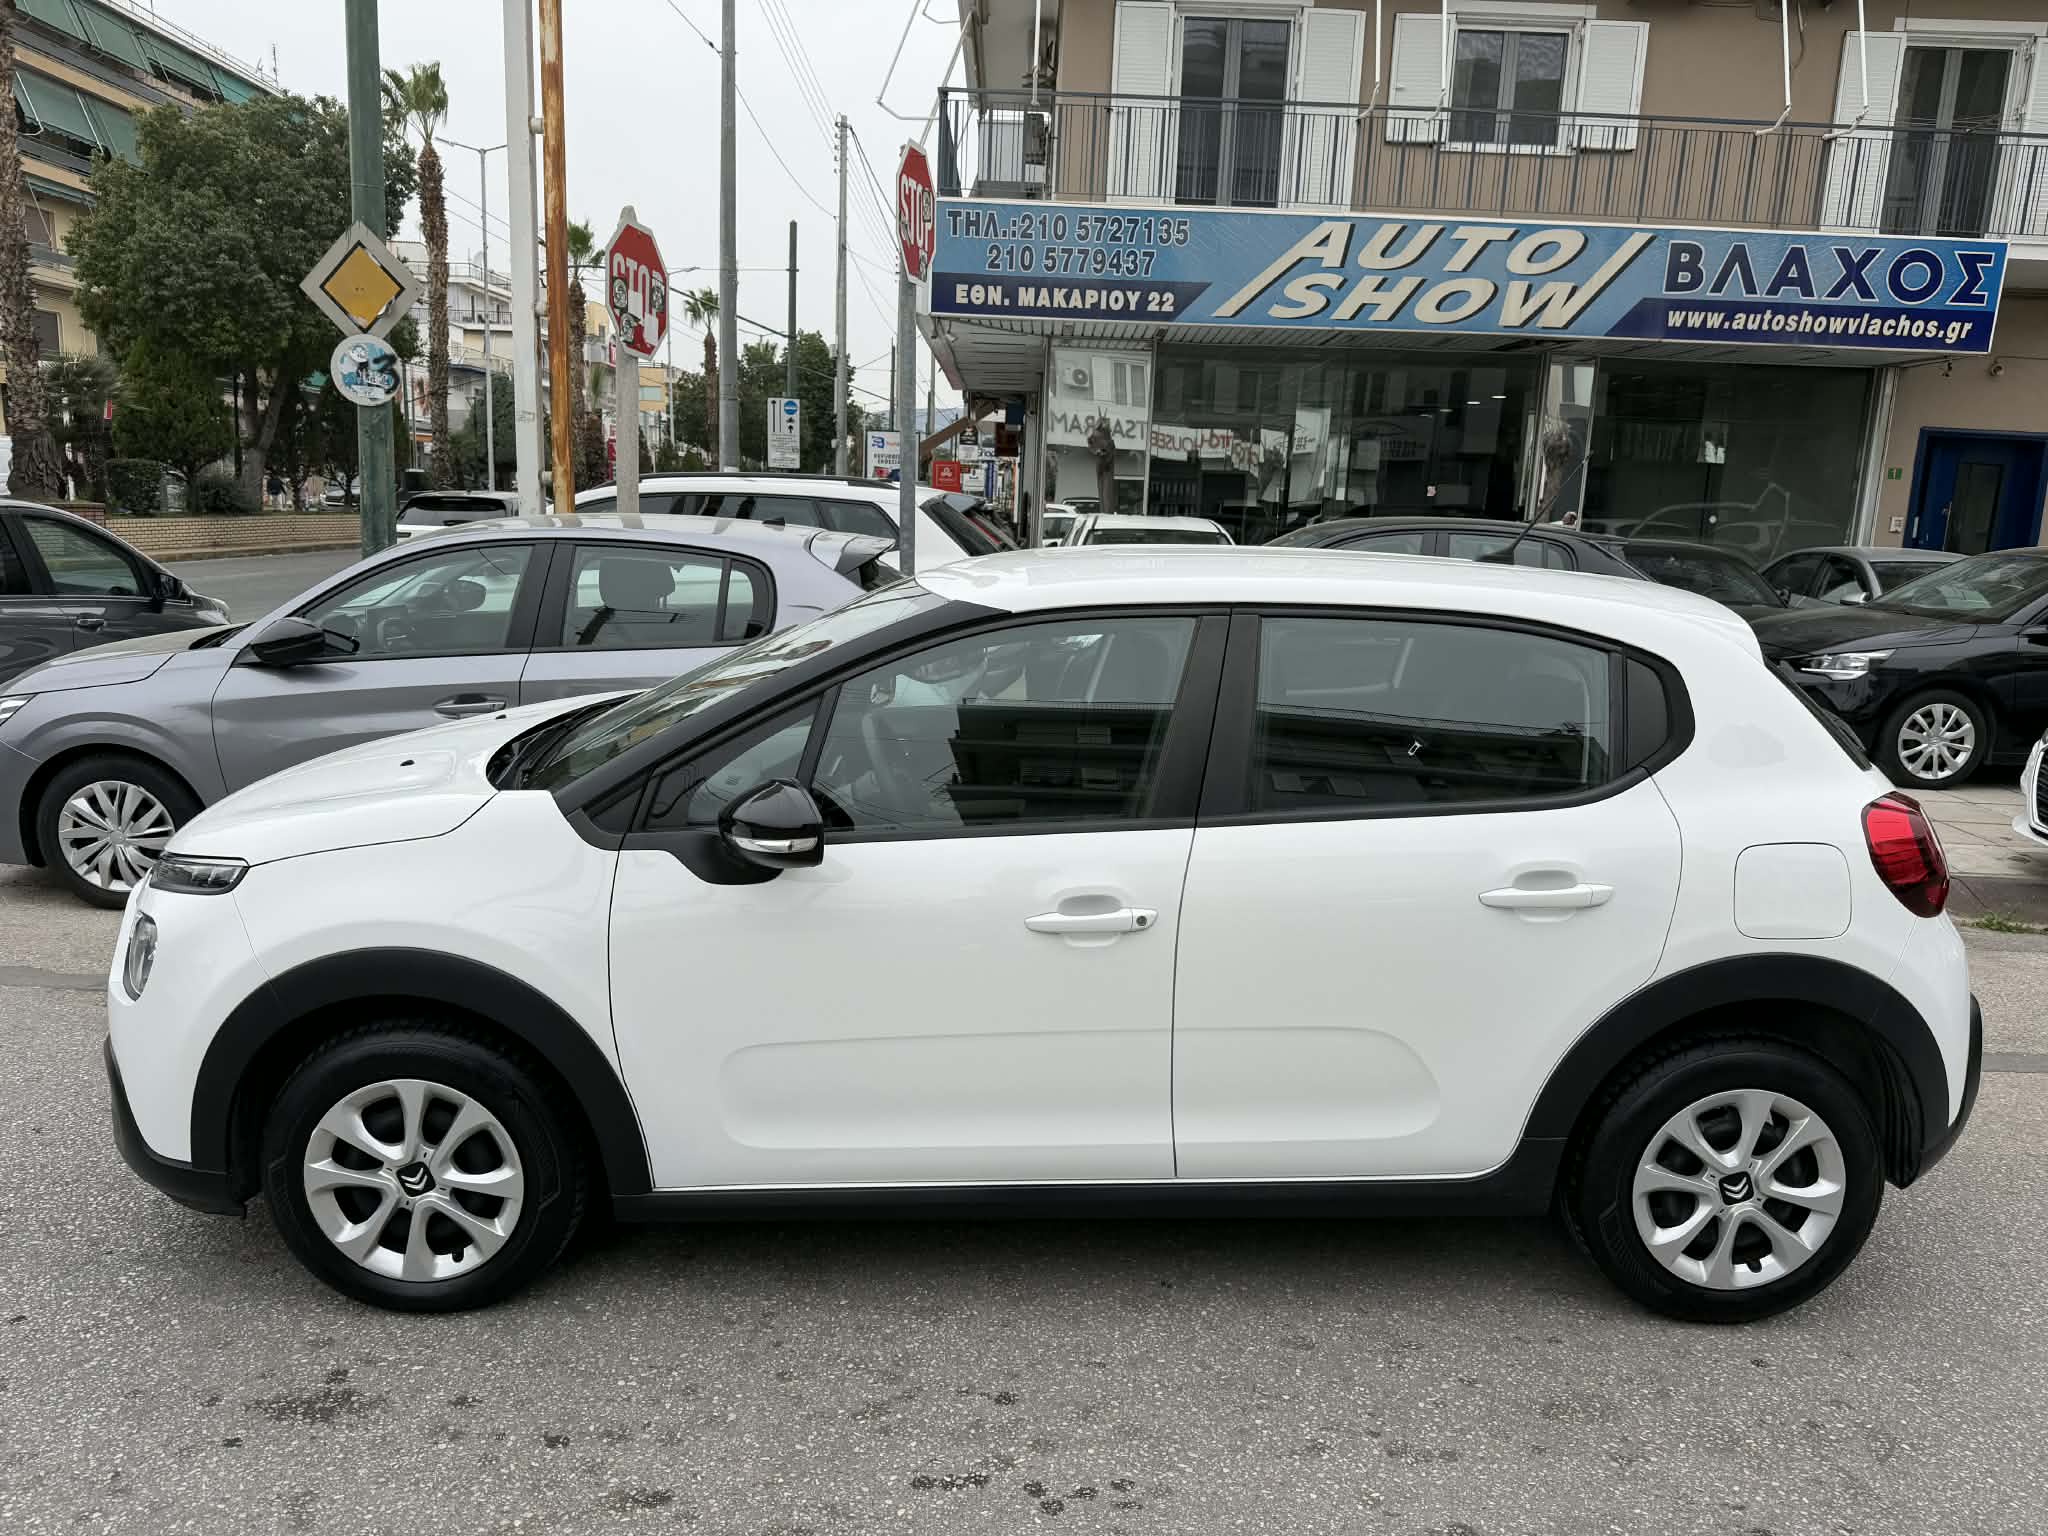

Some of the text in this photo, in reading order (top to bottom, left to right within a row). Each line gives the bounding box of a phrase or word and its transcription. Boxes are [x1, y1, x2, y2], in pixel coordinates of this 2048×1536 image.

[900, 173, 933, 253] STOP
[1075, 214, 1191, 247] 5727135
[986, 243, 1156, 276] 210 5779437
[1663, 240, 1995, 305] ΒΛΑΧΟΣ
[955, 283, 1175, 312] ΕΘΝ. ΜΑΚΑΡΙΟΥ 22
[1267, 232, 1657, 329] SHOW
[1667, 308, 1972, 344] www.autoshowvlachos.gr
